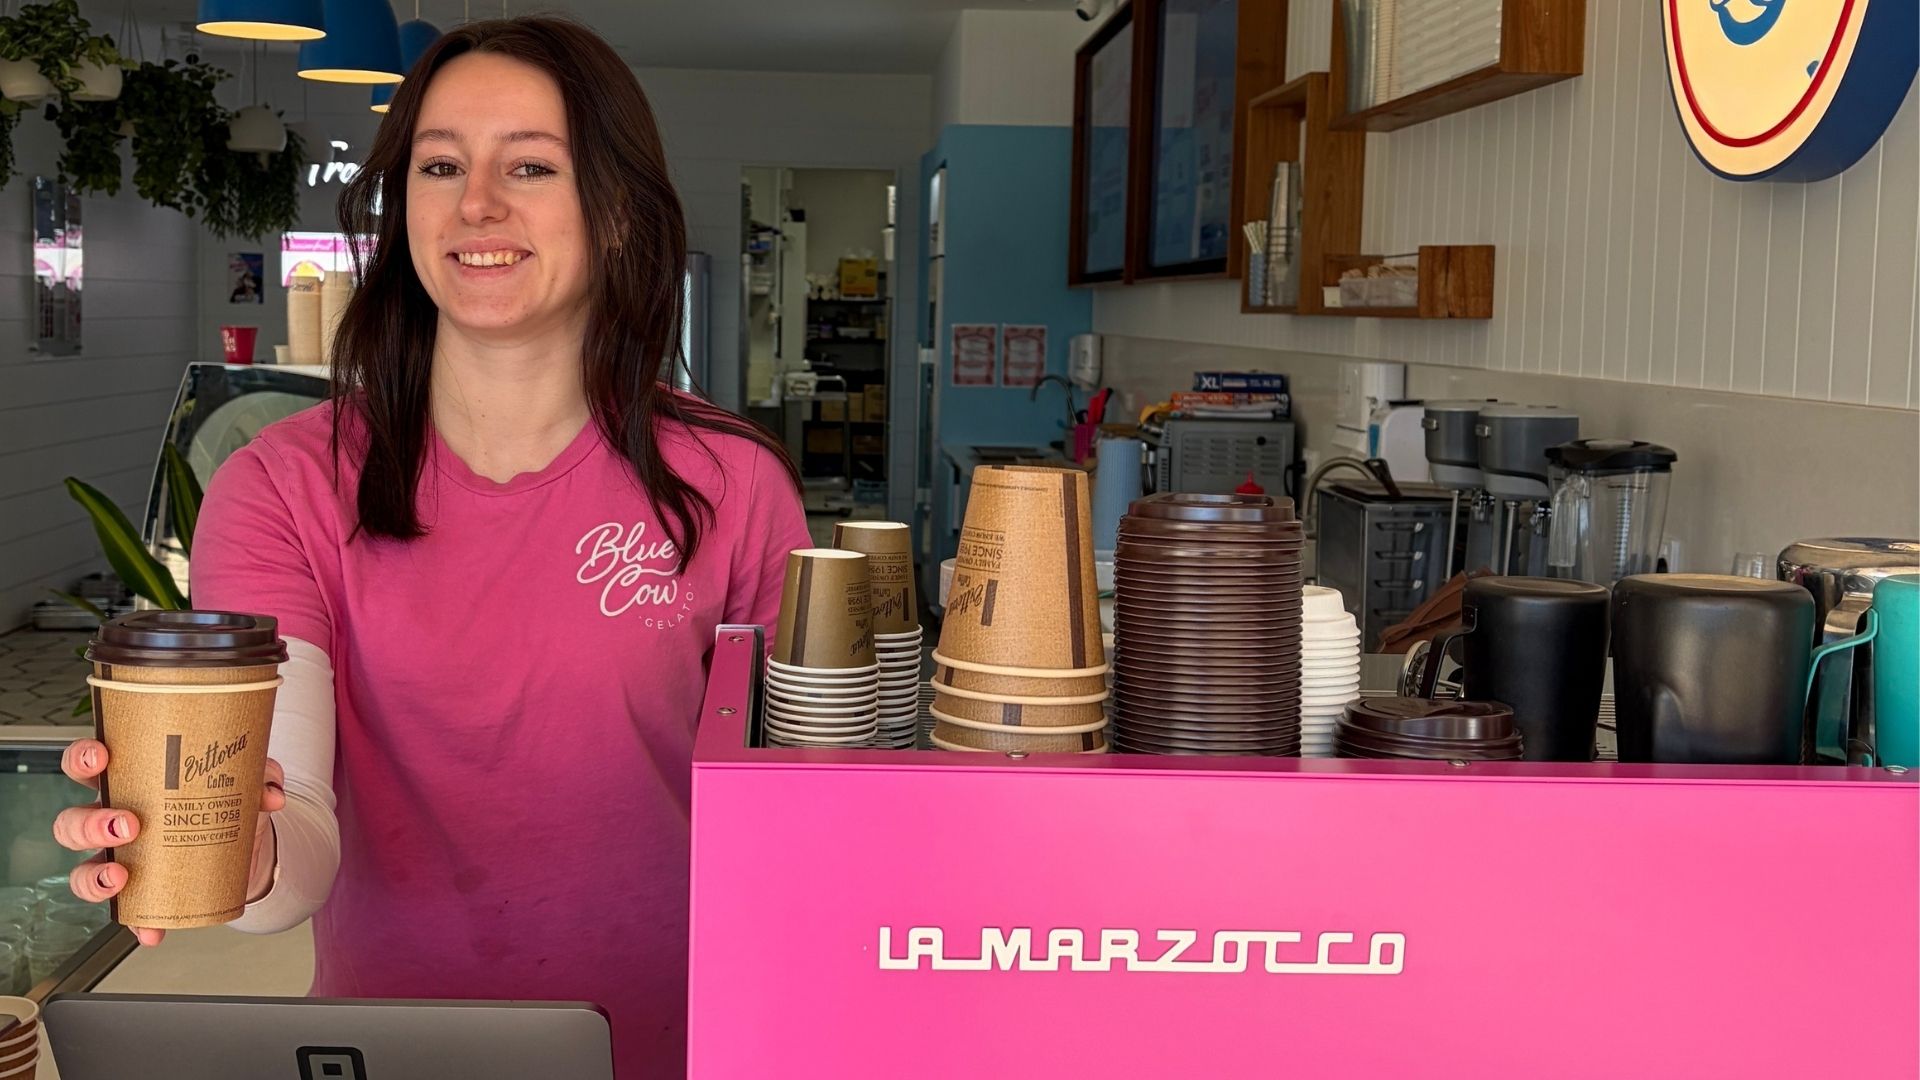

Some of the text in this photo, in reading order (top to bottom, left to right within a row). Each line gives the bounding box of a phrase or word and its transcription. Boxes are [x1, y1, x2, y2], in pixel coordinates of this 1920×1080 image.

[1201, 375, 1219, 389] XL
[575, 521, 676, 584] Blue
[972, 544, 1003, 559] SINCE
[888, 565, 908, 574] SINCE
[599, 561, 680, 617] Cow
[644, 591, 694, 630] GELATO
[184, 732, 248, 783] Vittoria
[206, 773, 235, 789] Coffee
[164, 798, 242, 812] FAMILY OWNED
[163, 809, 241, 826] SINCE 1958
[163, 835, 178, 843] WE
[180, 833, 208, 843] KNOW
[879, 926, 944, 971] LA
